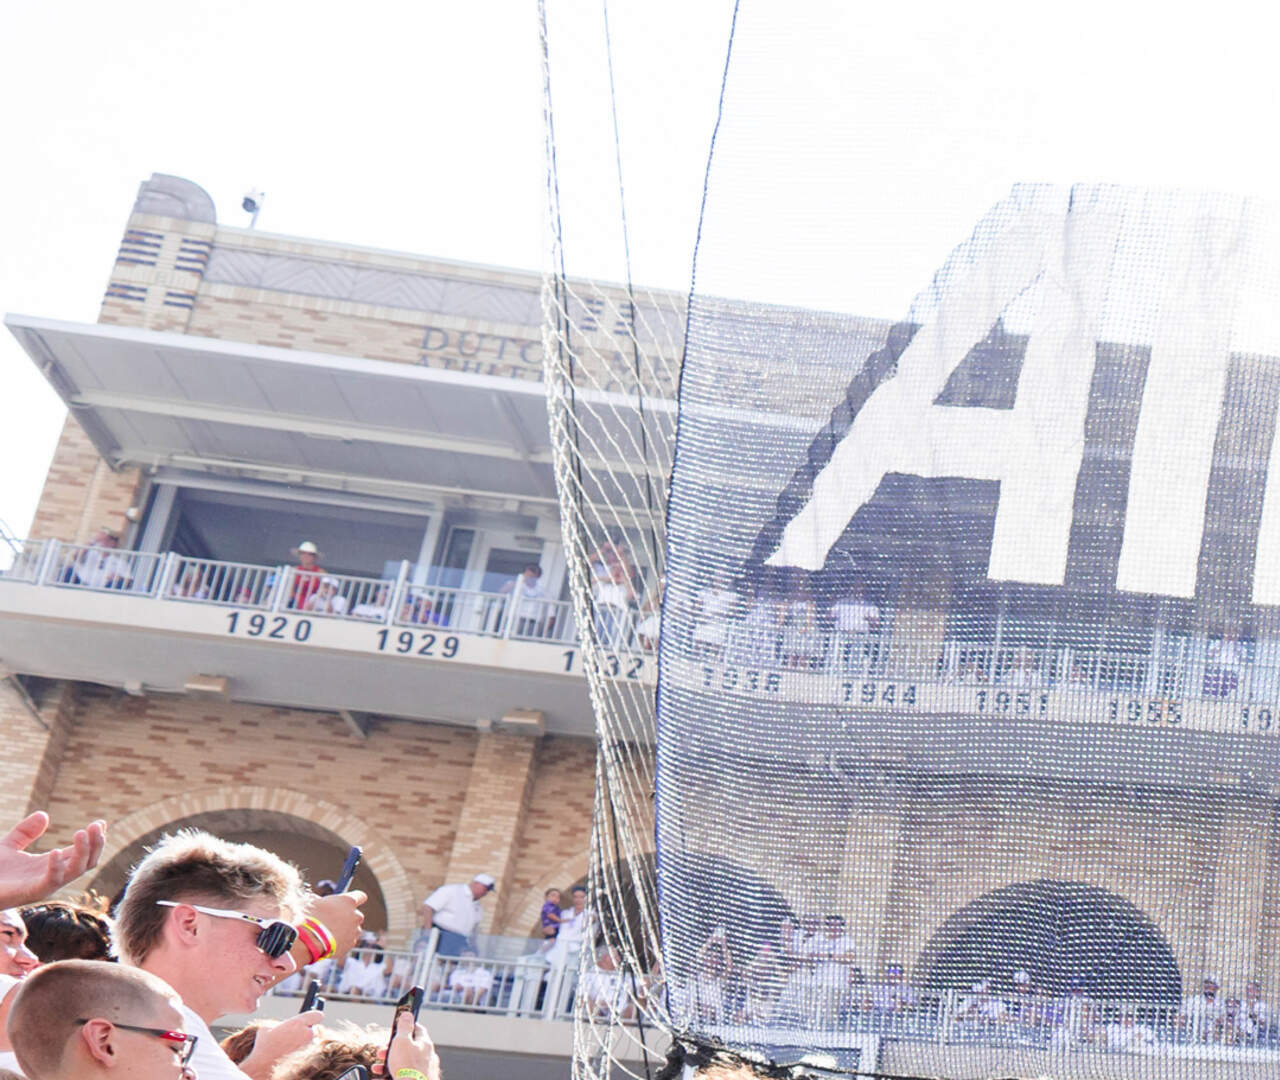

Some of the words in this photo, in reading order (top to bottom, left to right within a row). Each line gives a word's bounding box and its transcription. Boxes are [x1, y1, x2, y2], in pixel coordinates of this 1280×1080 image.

[226, 612, 312, 643] 1920
[376, 628, 460, 659] 1929
[562, 650, 644, 680] 132
[842, 682, 917, 705] 1944
[976, 690, 1050, 714] 1951
[1110, 699, 1183, 724] 1955
